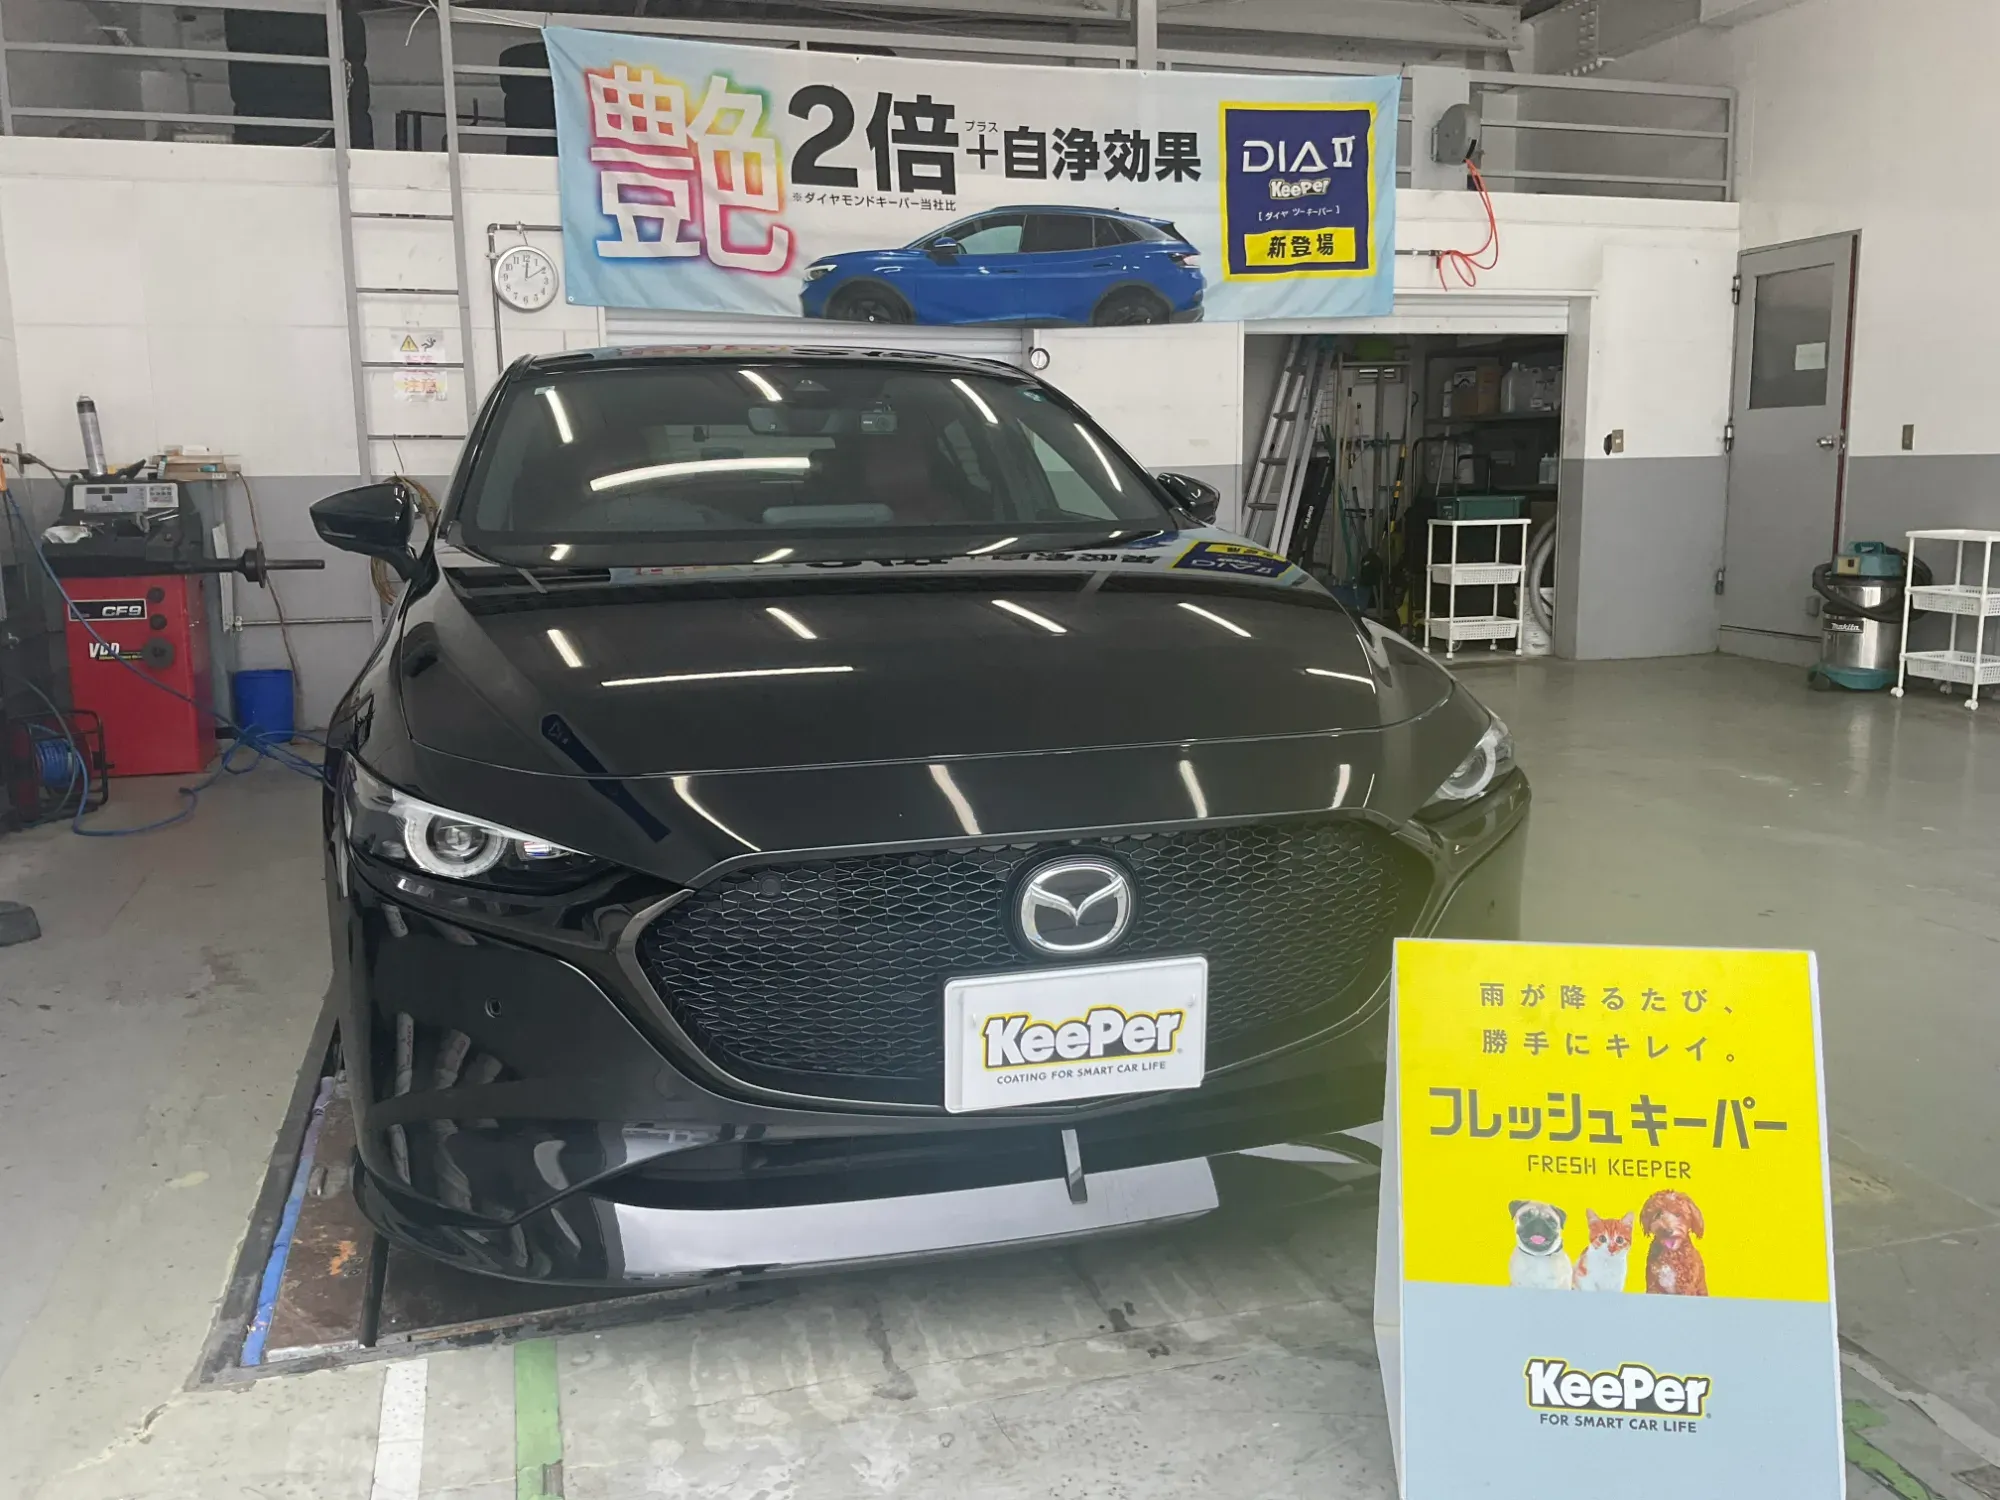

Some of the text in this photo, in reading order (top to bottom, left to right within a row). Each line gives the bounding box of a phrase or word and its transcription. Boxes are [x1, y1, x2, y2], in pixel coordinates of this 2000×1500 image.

[965, 121, 998, 133] プラス
[1243, 140, 1328, 173] DIA
[1267, 233, 1334, 259] 新登場
[101, 605, 142, 617] CF9
[1480, 982, 1733, 1014] 雨が降るたび、
[984, 1006, 1184, 1068] KeePer
[1482, 1029, 1735, 1063] 勝手にキレイ。
[997, 1061, 1166, 1085] COATING FOR SMART CAR LIFE
[1429, 1086, 1788, 1150] フレッシュキーパー
[1527, 1154, 1691, 1179] FRESH KEEPER
[1526, 1358, 1711, 1416] KeePer
[1539, 1413, 1697, 1434] FOR SMART CAR LIFE
